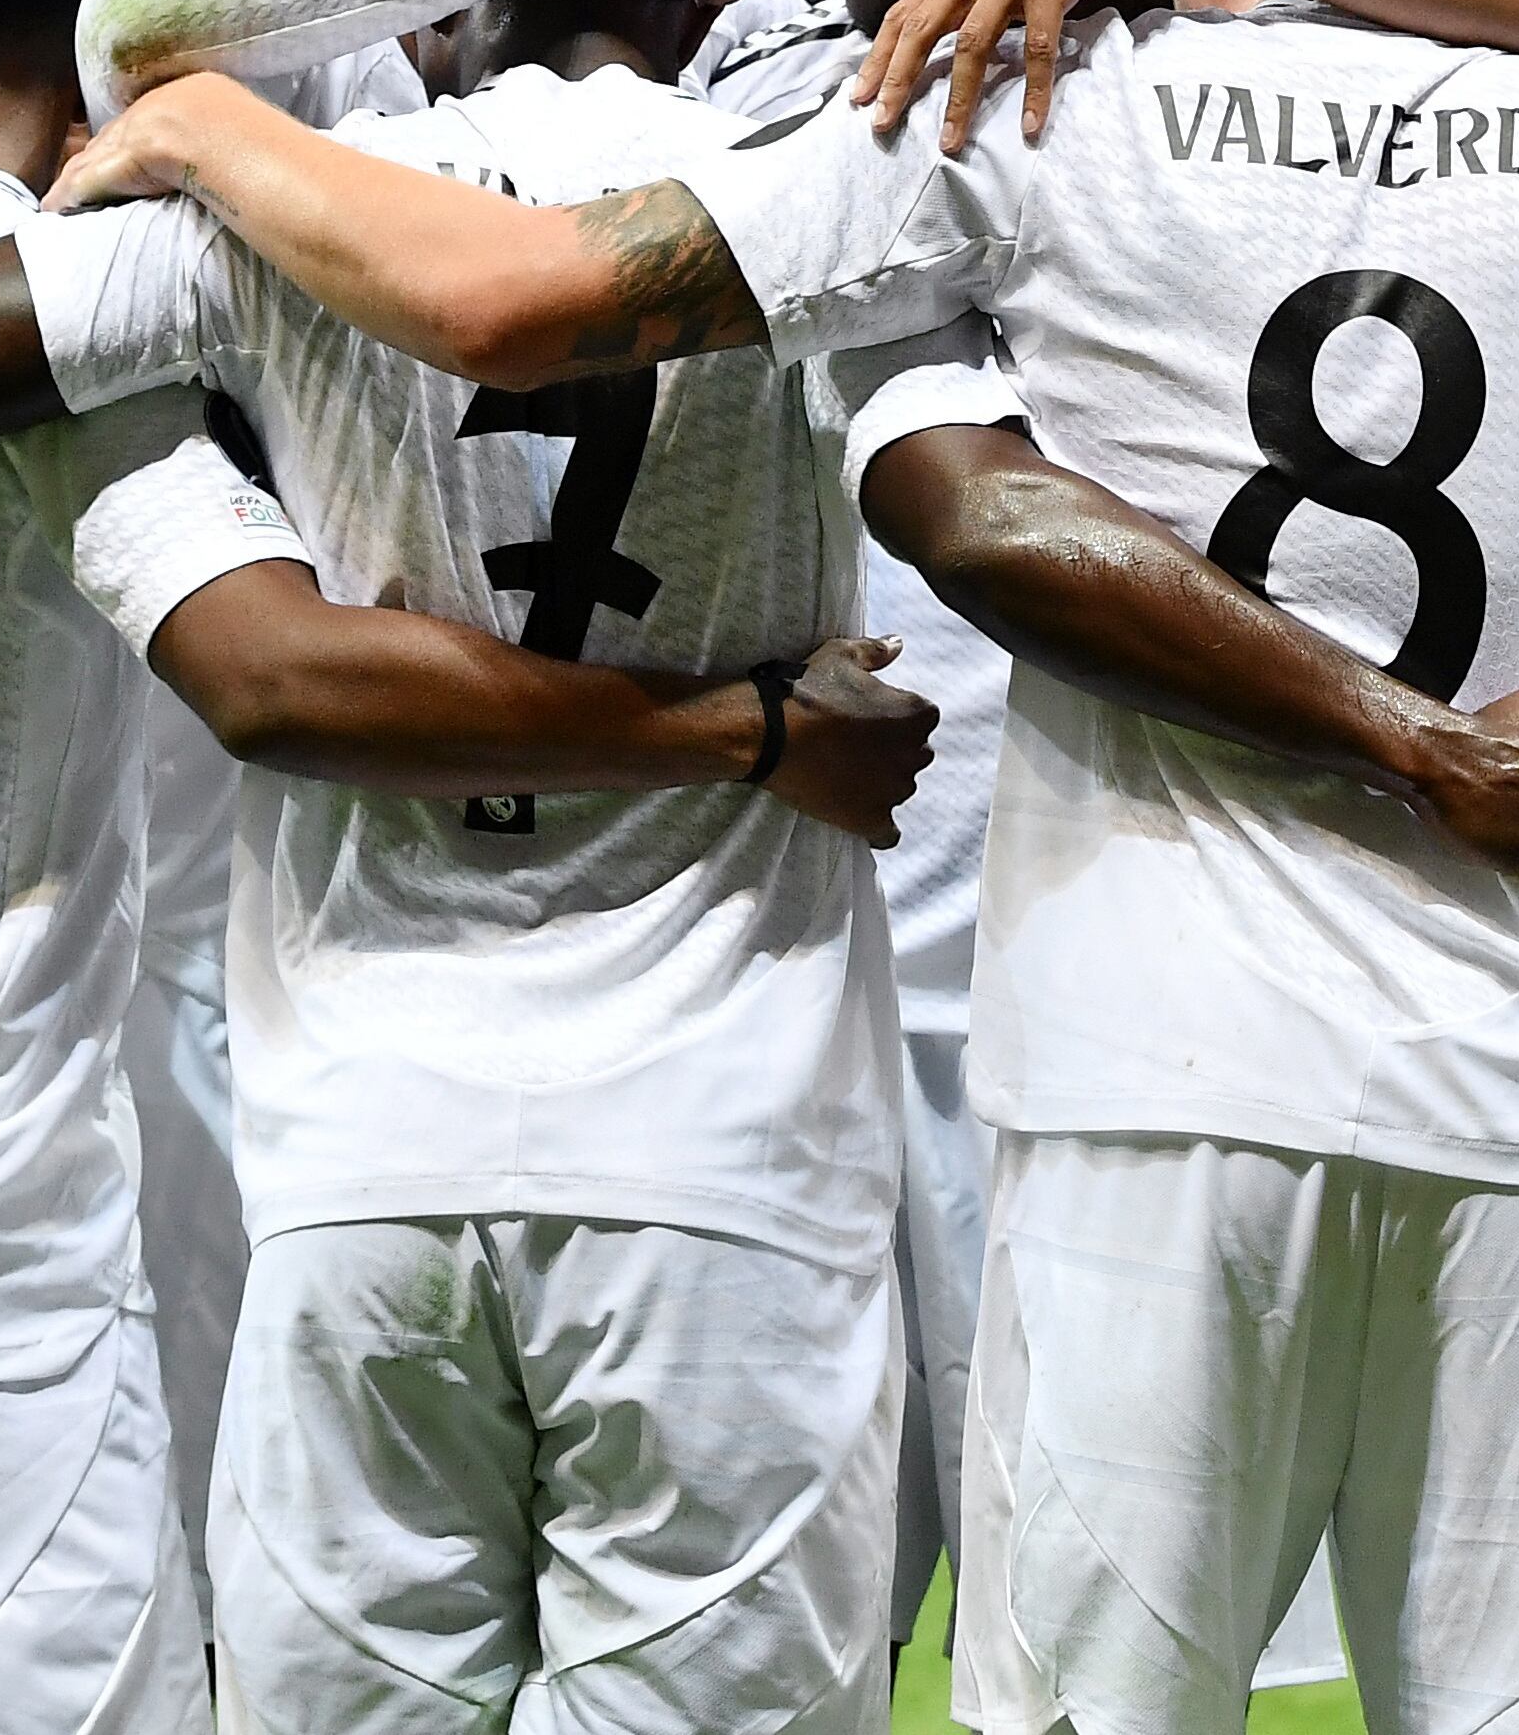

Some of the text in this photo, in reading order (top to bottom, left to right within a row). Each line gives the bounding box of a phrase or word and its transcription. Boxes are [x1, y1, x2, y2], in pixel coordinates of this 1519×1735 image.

[229, 495, 263, 506] UEFA
[454, 363, 663, 833] 7
[1207, 268, 1487, 715] 8
